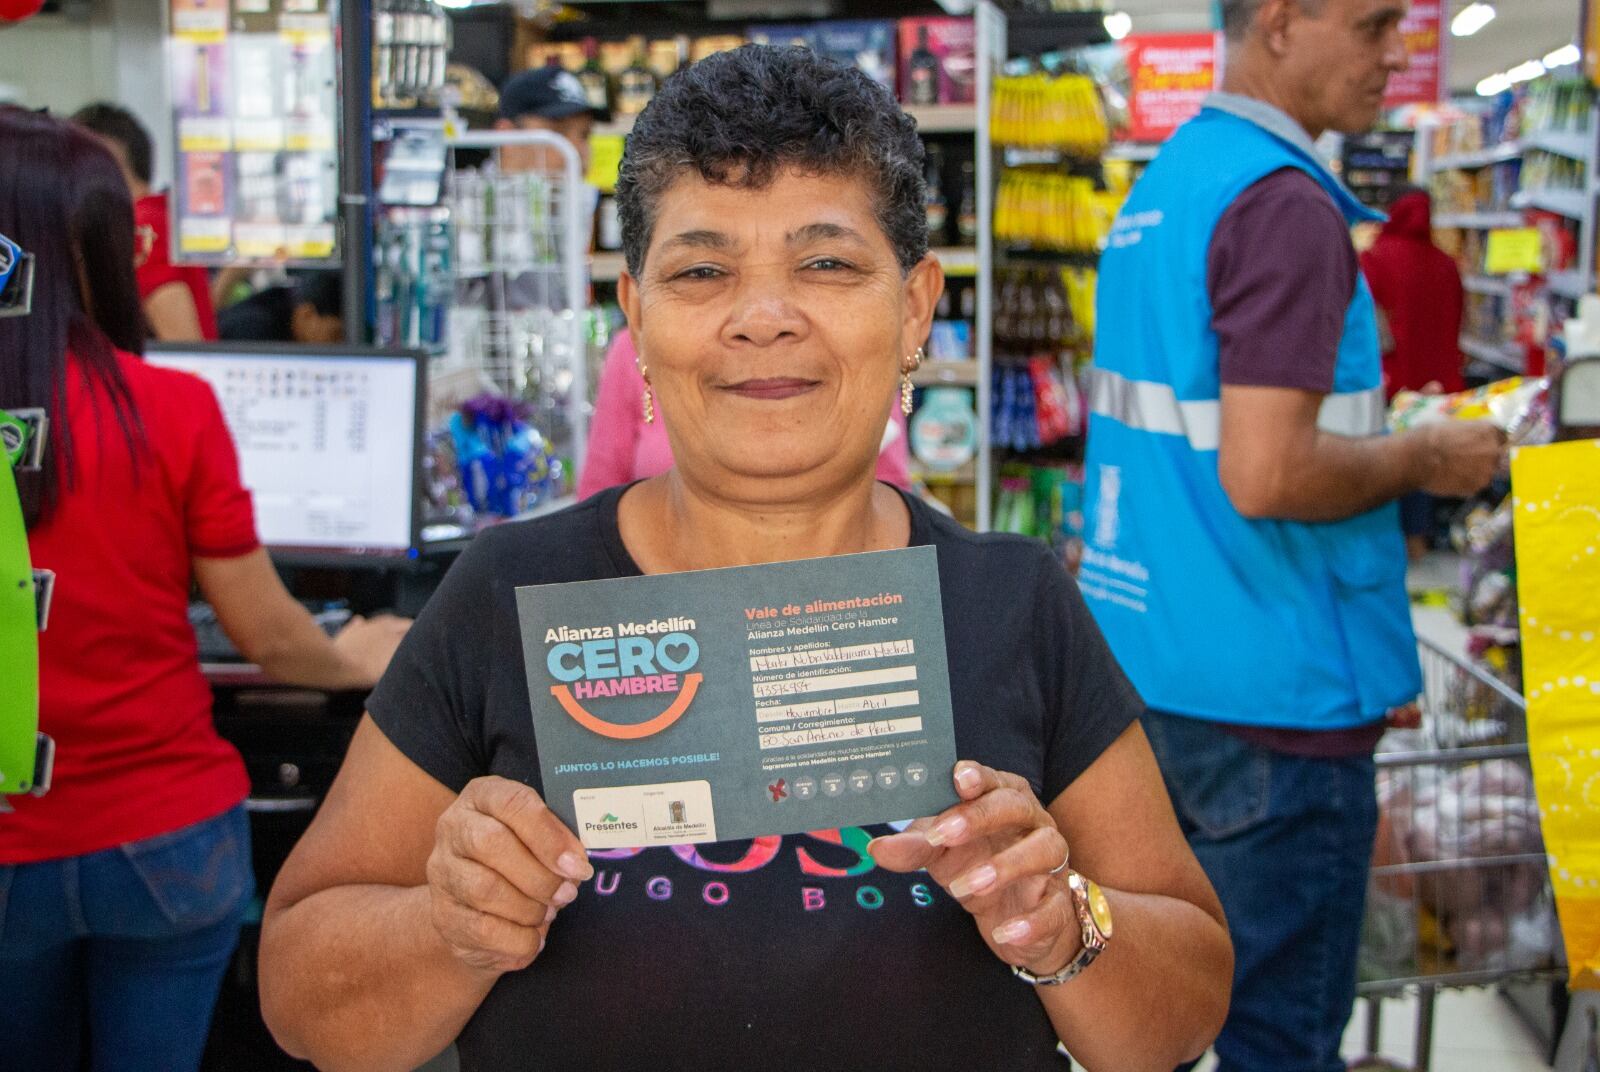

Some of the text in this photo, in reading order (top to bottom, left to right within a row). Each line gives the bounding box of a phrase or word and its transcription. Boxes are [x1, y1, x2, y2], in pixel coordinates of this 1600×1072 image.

[744, 592, 902, 620] Vale de alimentación
[748, 616, 898, 640] Alianza Medellín Cero Hambre
[775, 619, 787, 628] de
[845, 611, 857, 620] de
[543, 616, 696, 643] Alianza Medellín
[547, 632, 700, 682] CERO
[749, 641, 831, 656] Nombres y apellidos:
[752, 665, 852, 682] Número de identificación:
[574, 673, 678, 699] HAMBRE
[755, 699, 781, 707] Fecha:
[758, 717, 856, 734] Comuna / Corregimiento:
[554, 752, 721, 775] ¡JUNTOS LO HACEMOS POSIBLE!
[856, 780, 864, 788] 4
[885, 776, 892, 785] 5
[913, 772, 920, 781] 6
[802, 787, 809, 795] 2
[830, 783, 837, 792] 3
[585, 821, 638, 831] Presentes
